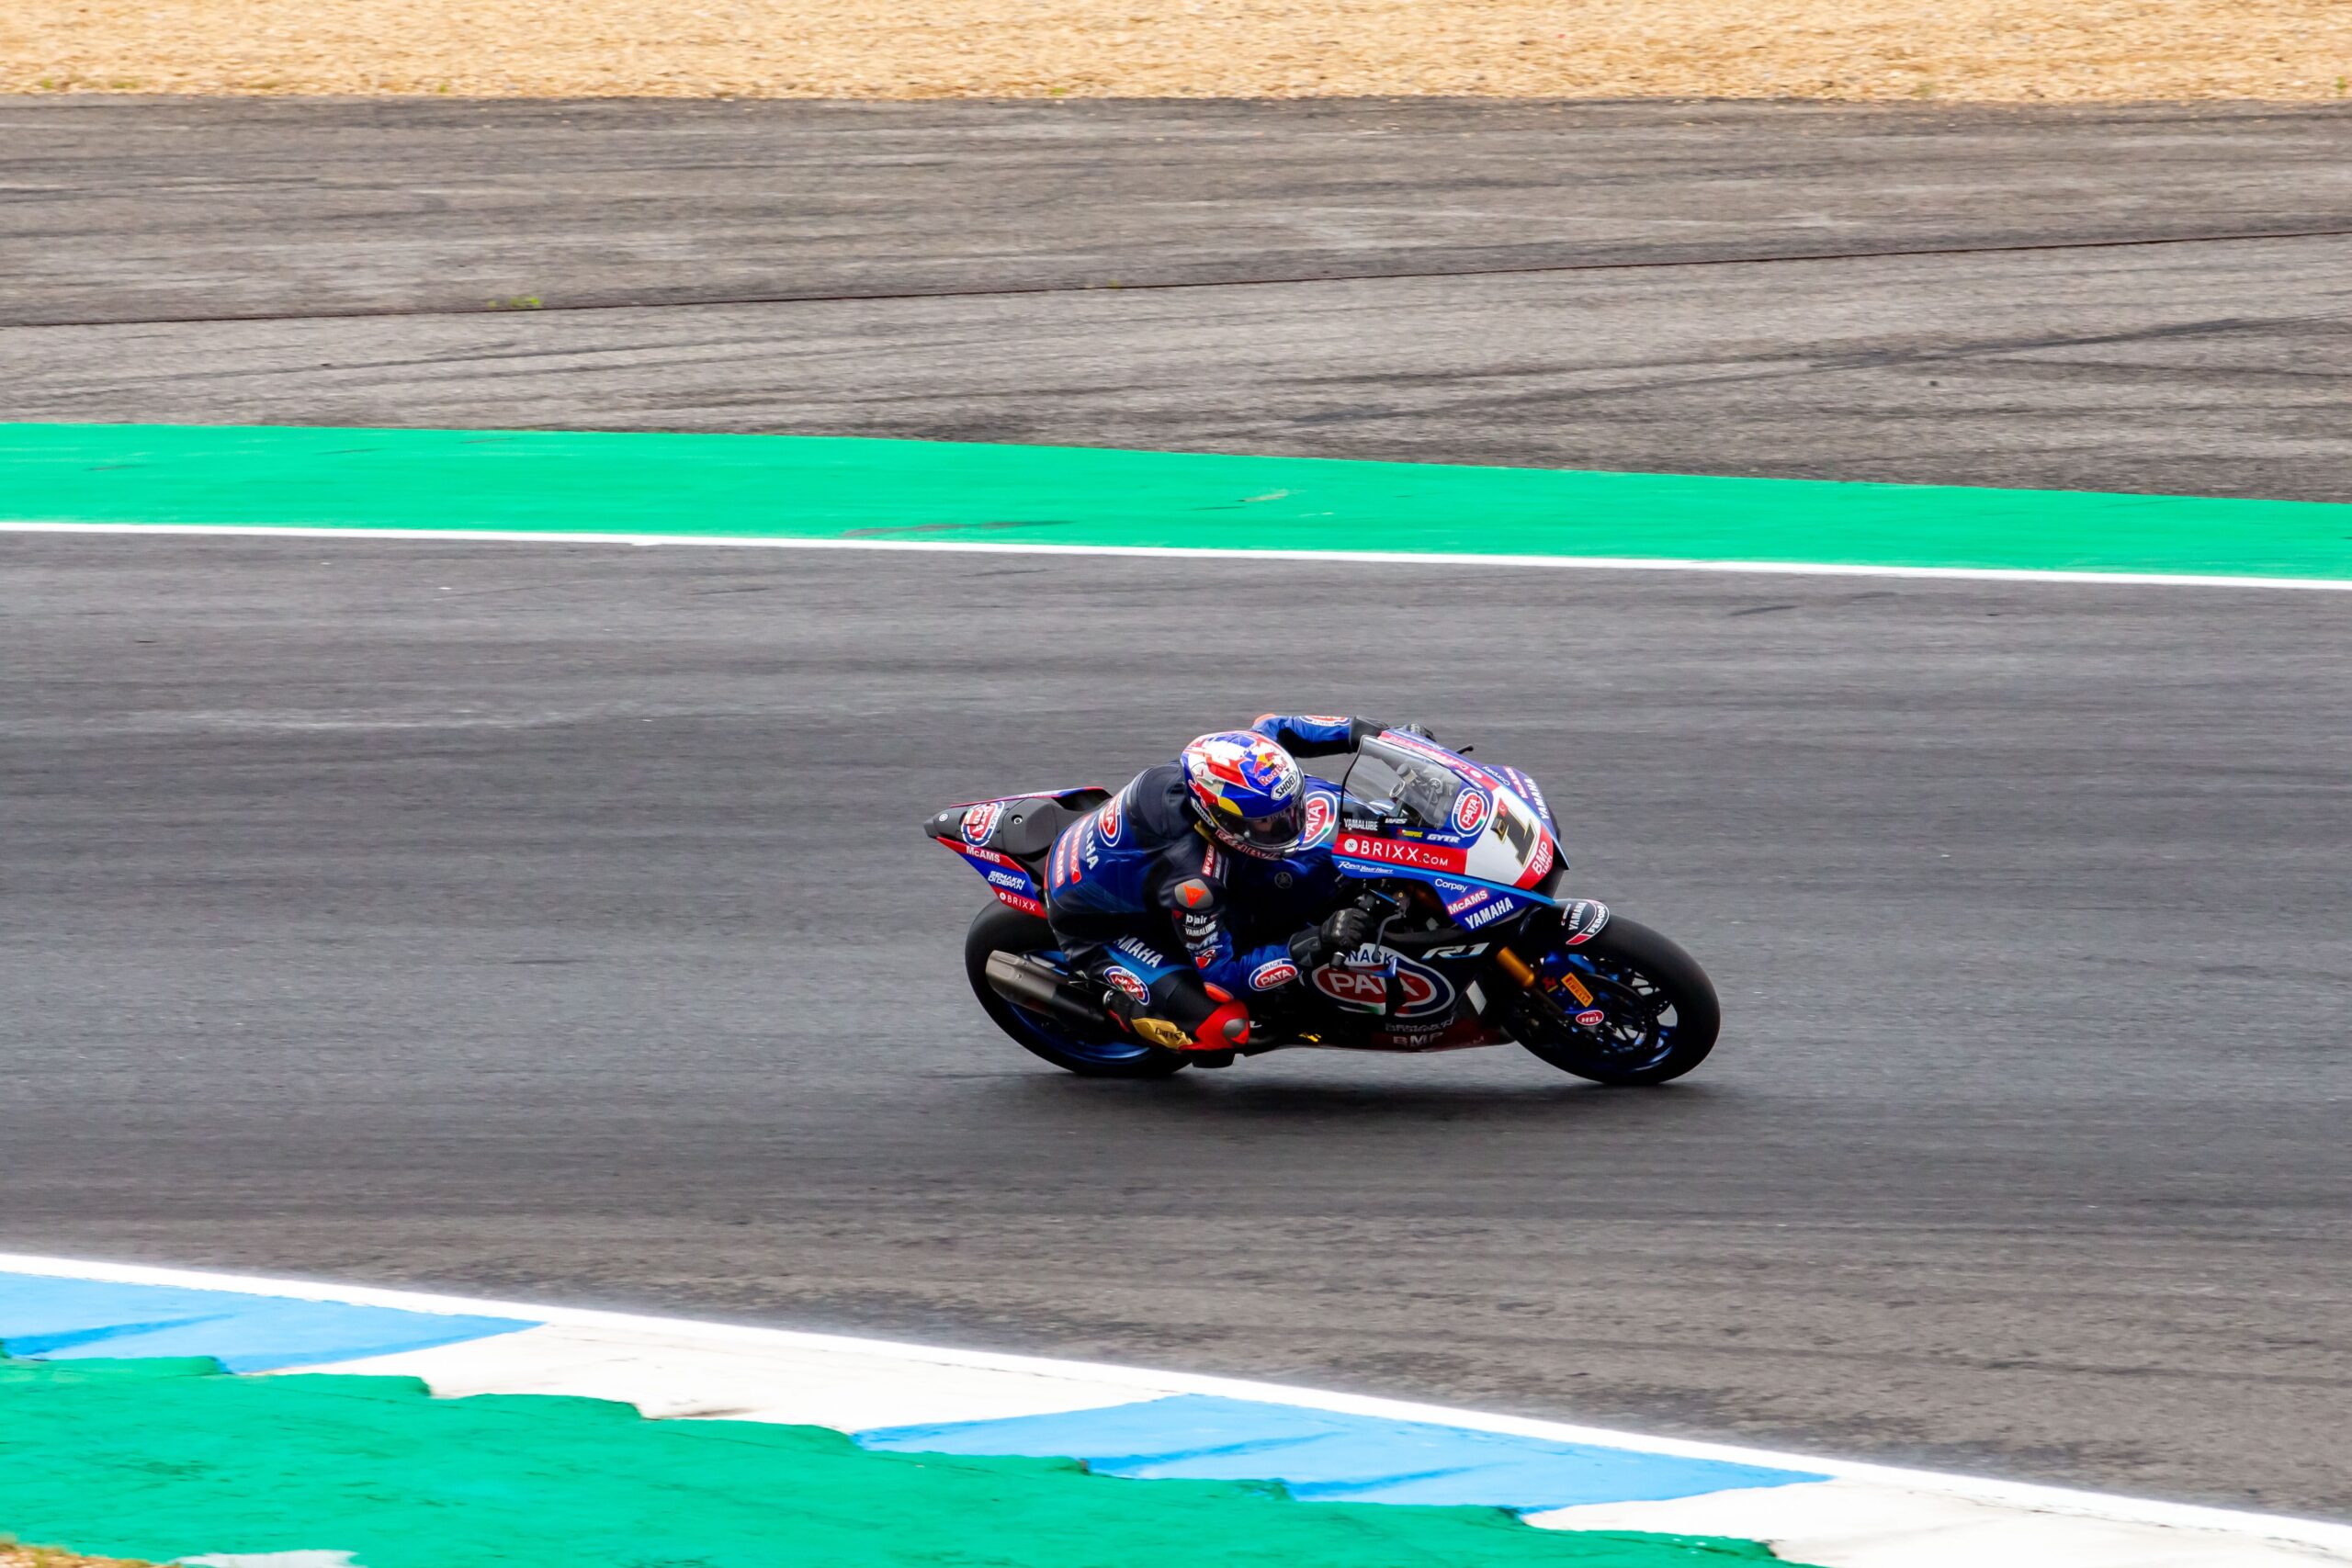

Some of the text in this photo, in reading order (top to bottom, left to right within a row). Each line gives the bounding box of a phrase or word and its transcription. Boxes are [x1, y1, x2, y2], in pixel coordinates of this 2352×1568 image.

[1524, 778, 1550, 819] YAMAHA
[1461, 793, 1480, 826] PATA
[1343, 818, 1378, 831] YAMALUBE
[1427, 834, 1461, 844] GYTR
[967, 845, 1001, 863] McAMS
[1532, 840, 1548, 875] BMP
[1435, 878, 1468, 893] Corpay
[1007, 893, 1036, 911] BRIXX
[1448, 890, 1488, 915] McAMS
[1464, 897, 1514, 930] YAMAHA
[1568, 902, 1589, 931] YAMAHA
[1114, 934, 1164, 968] AMAHA
[1348, 949, 1393, 964] NACK
[1261, 961, 1282, 972] SNACK
[1259, 969, 1292, 987] PATA
[1394, 1032, 1444, 1050] BMP
